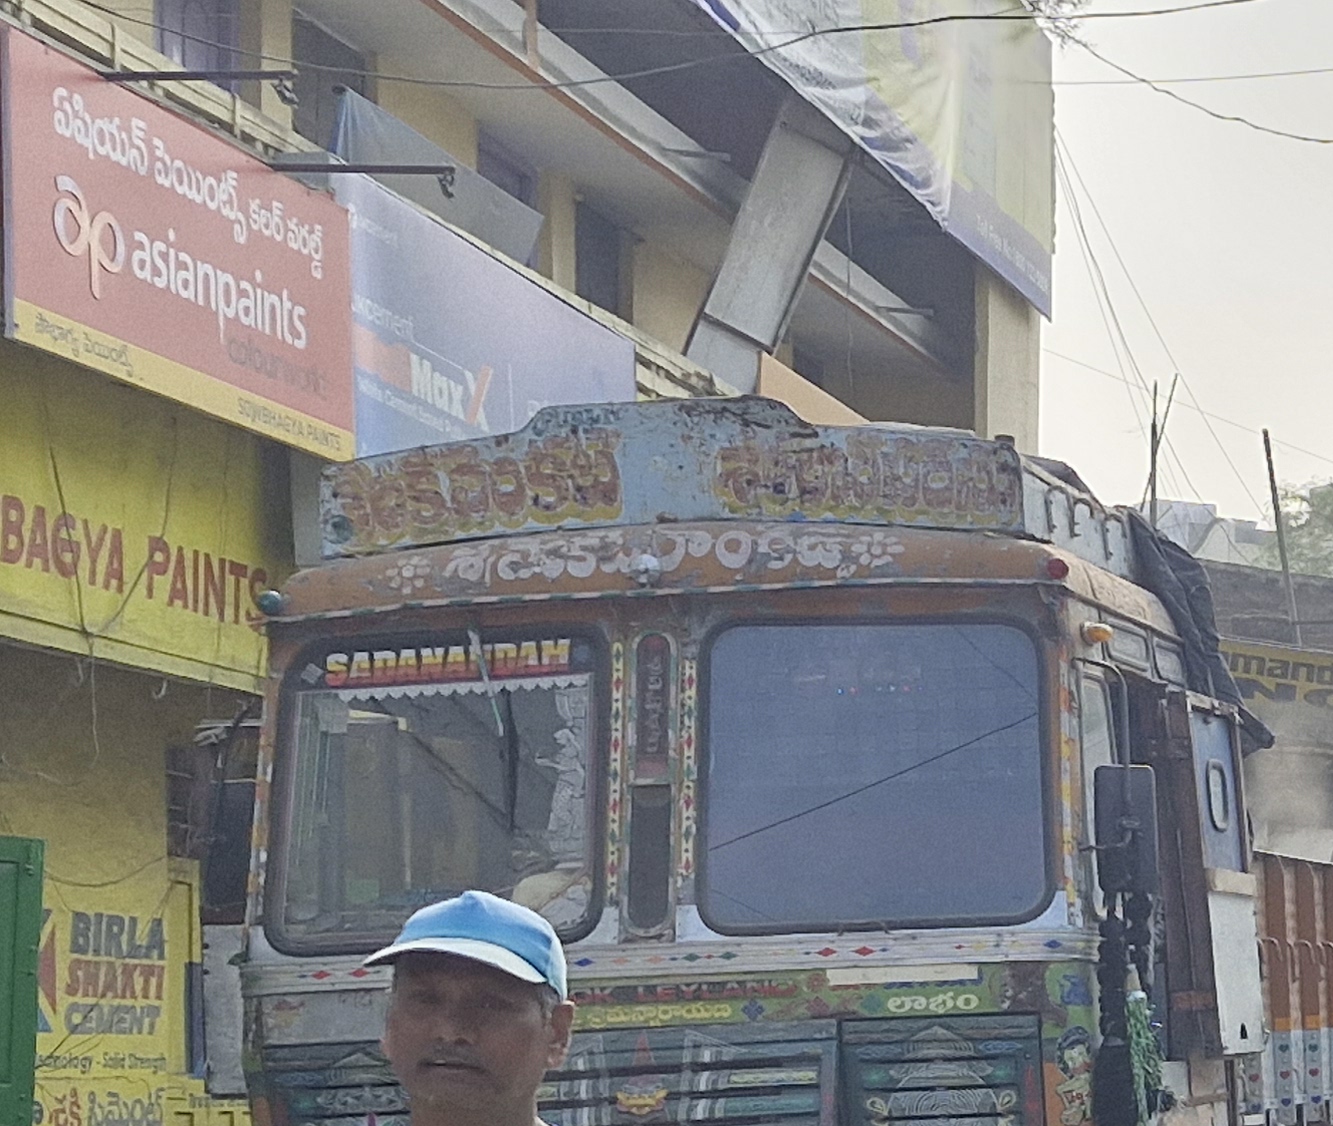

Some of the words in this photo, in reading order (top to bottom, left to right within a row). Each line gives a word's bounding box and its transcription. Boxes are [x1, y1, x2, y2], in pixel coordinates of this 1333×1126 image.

[132, 229, 307, 350] asianpaints
[70, 911, 166, 960] BIRLA
[64, 959, 165, 1001] SHAKTI
[63, 1001, 161, 1036] CEMENT
[887, 991, 979, 1014] లాభం
